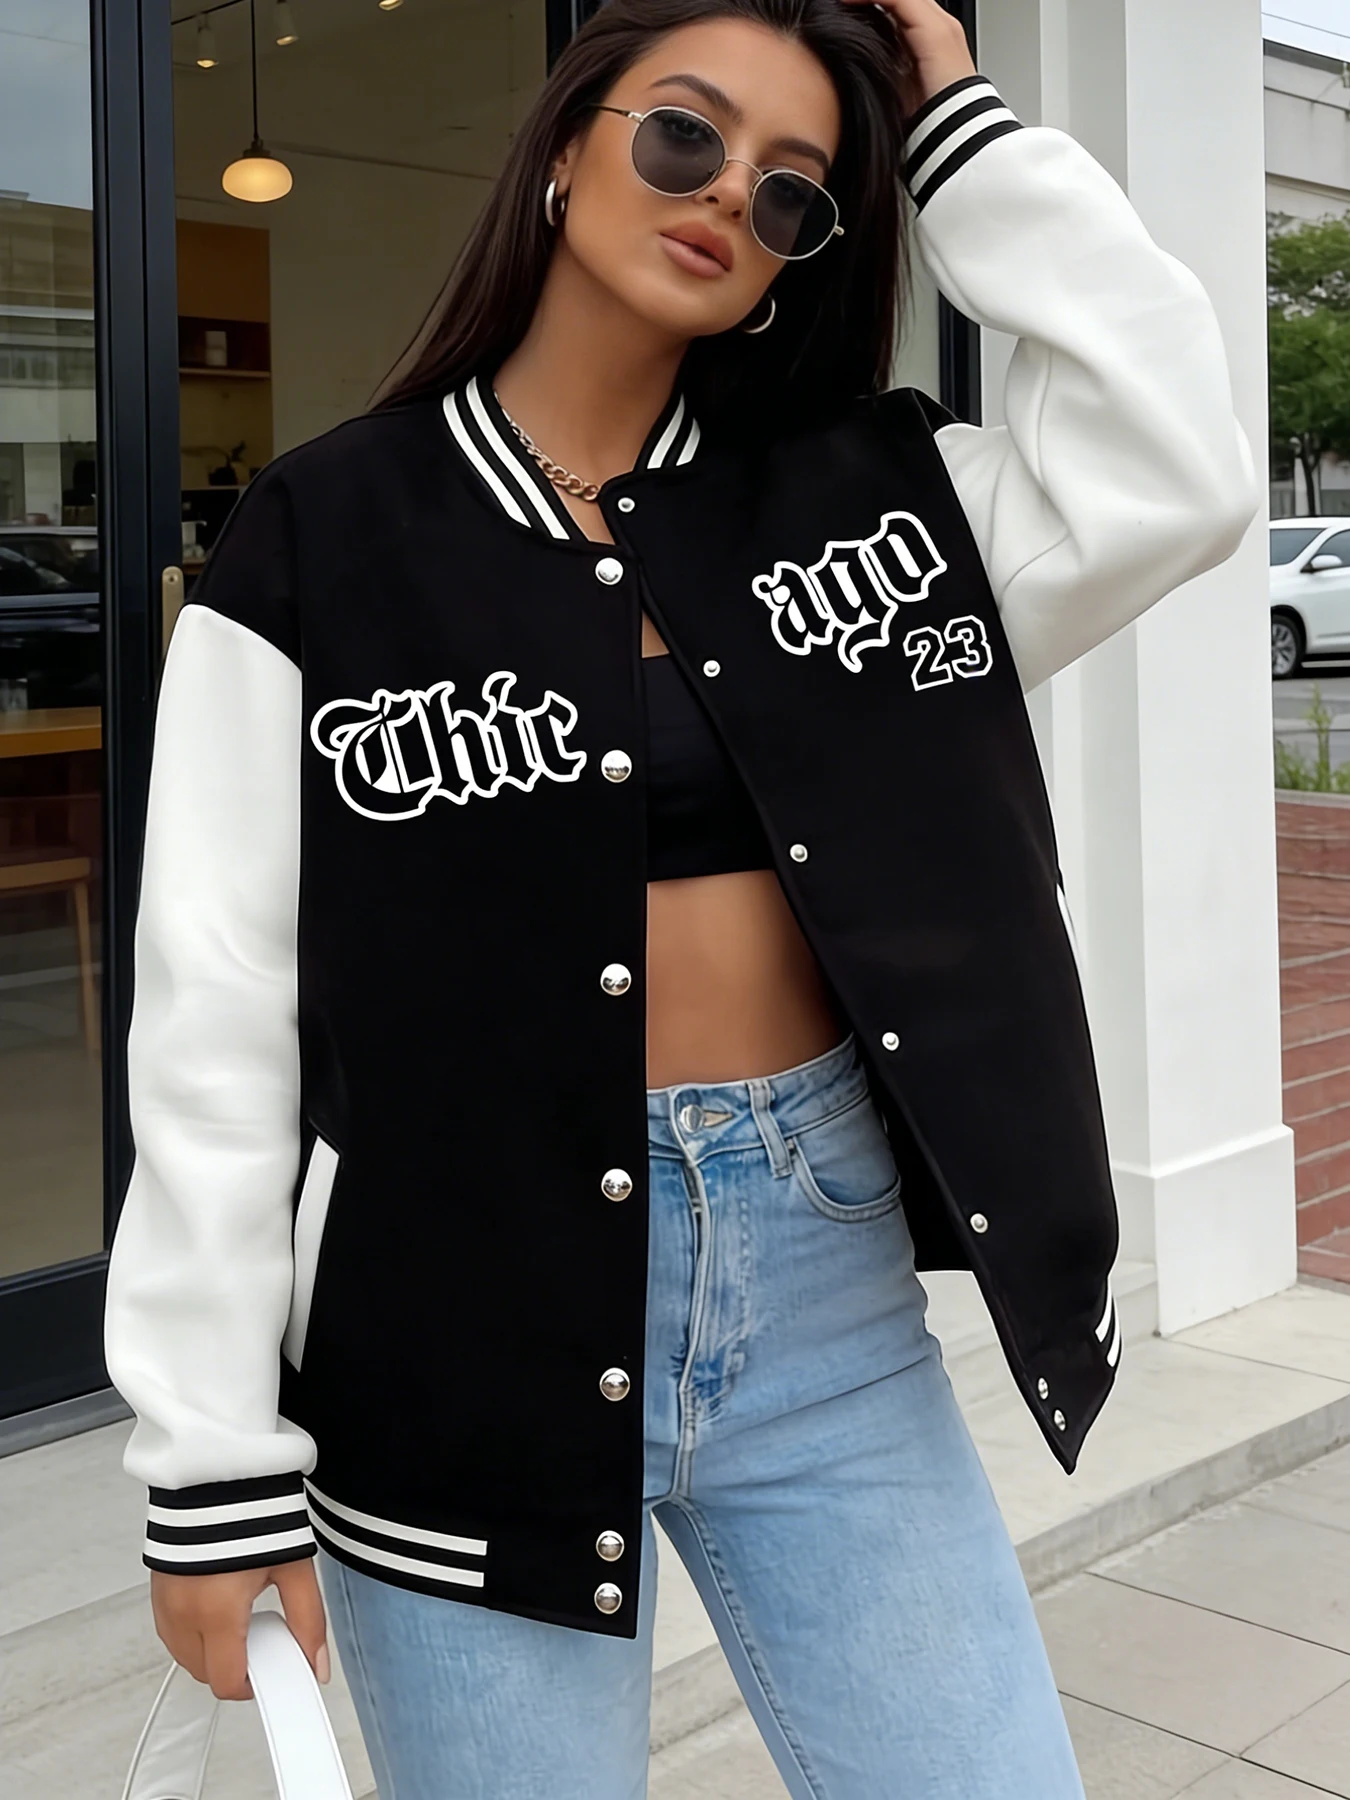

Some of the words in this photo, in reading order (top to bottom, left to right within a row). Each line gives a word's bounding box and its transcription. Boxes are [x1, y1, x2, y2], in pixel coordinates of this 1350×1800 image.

[752, 511, 947, 673] ago
[903, 614, 993, 692] 23
[310, 671, 587, 821] Chic
